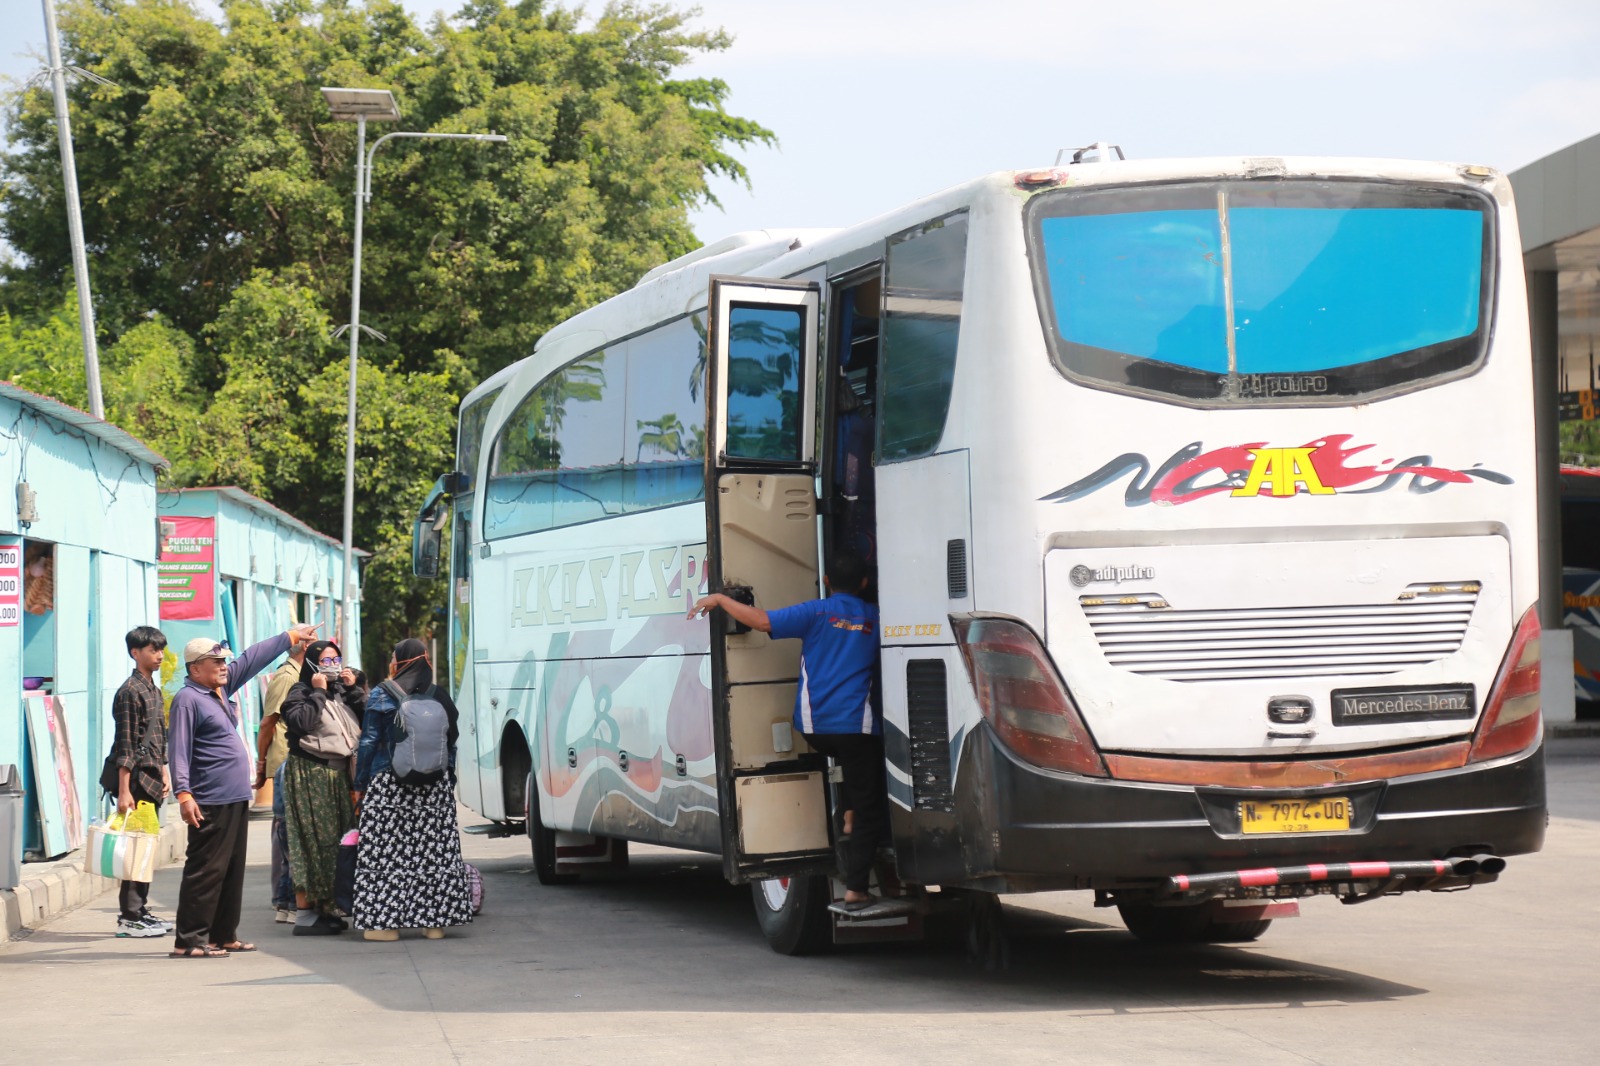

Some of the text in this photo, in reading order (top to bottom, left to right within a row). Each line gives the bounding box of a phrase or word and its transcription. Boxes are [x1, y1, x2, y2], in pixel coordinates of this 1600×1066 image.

[168, 537, 213, 546] PUCUK TEH
[169, 545, 202, 553] PILIHAN
[617, 542, 709, 620] ASR
[1343, 693, 1469, 716] Mercedes-Benz
